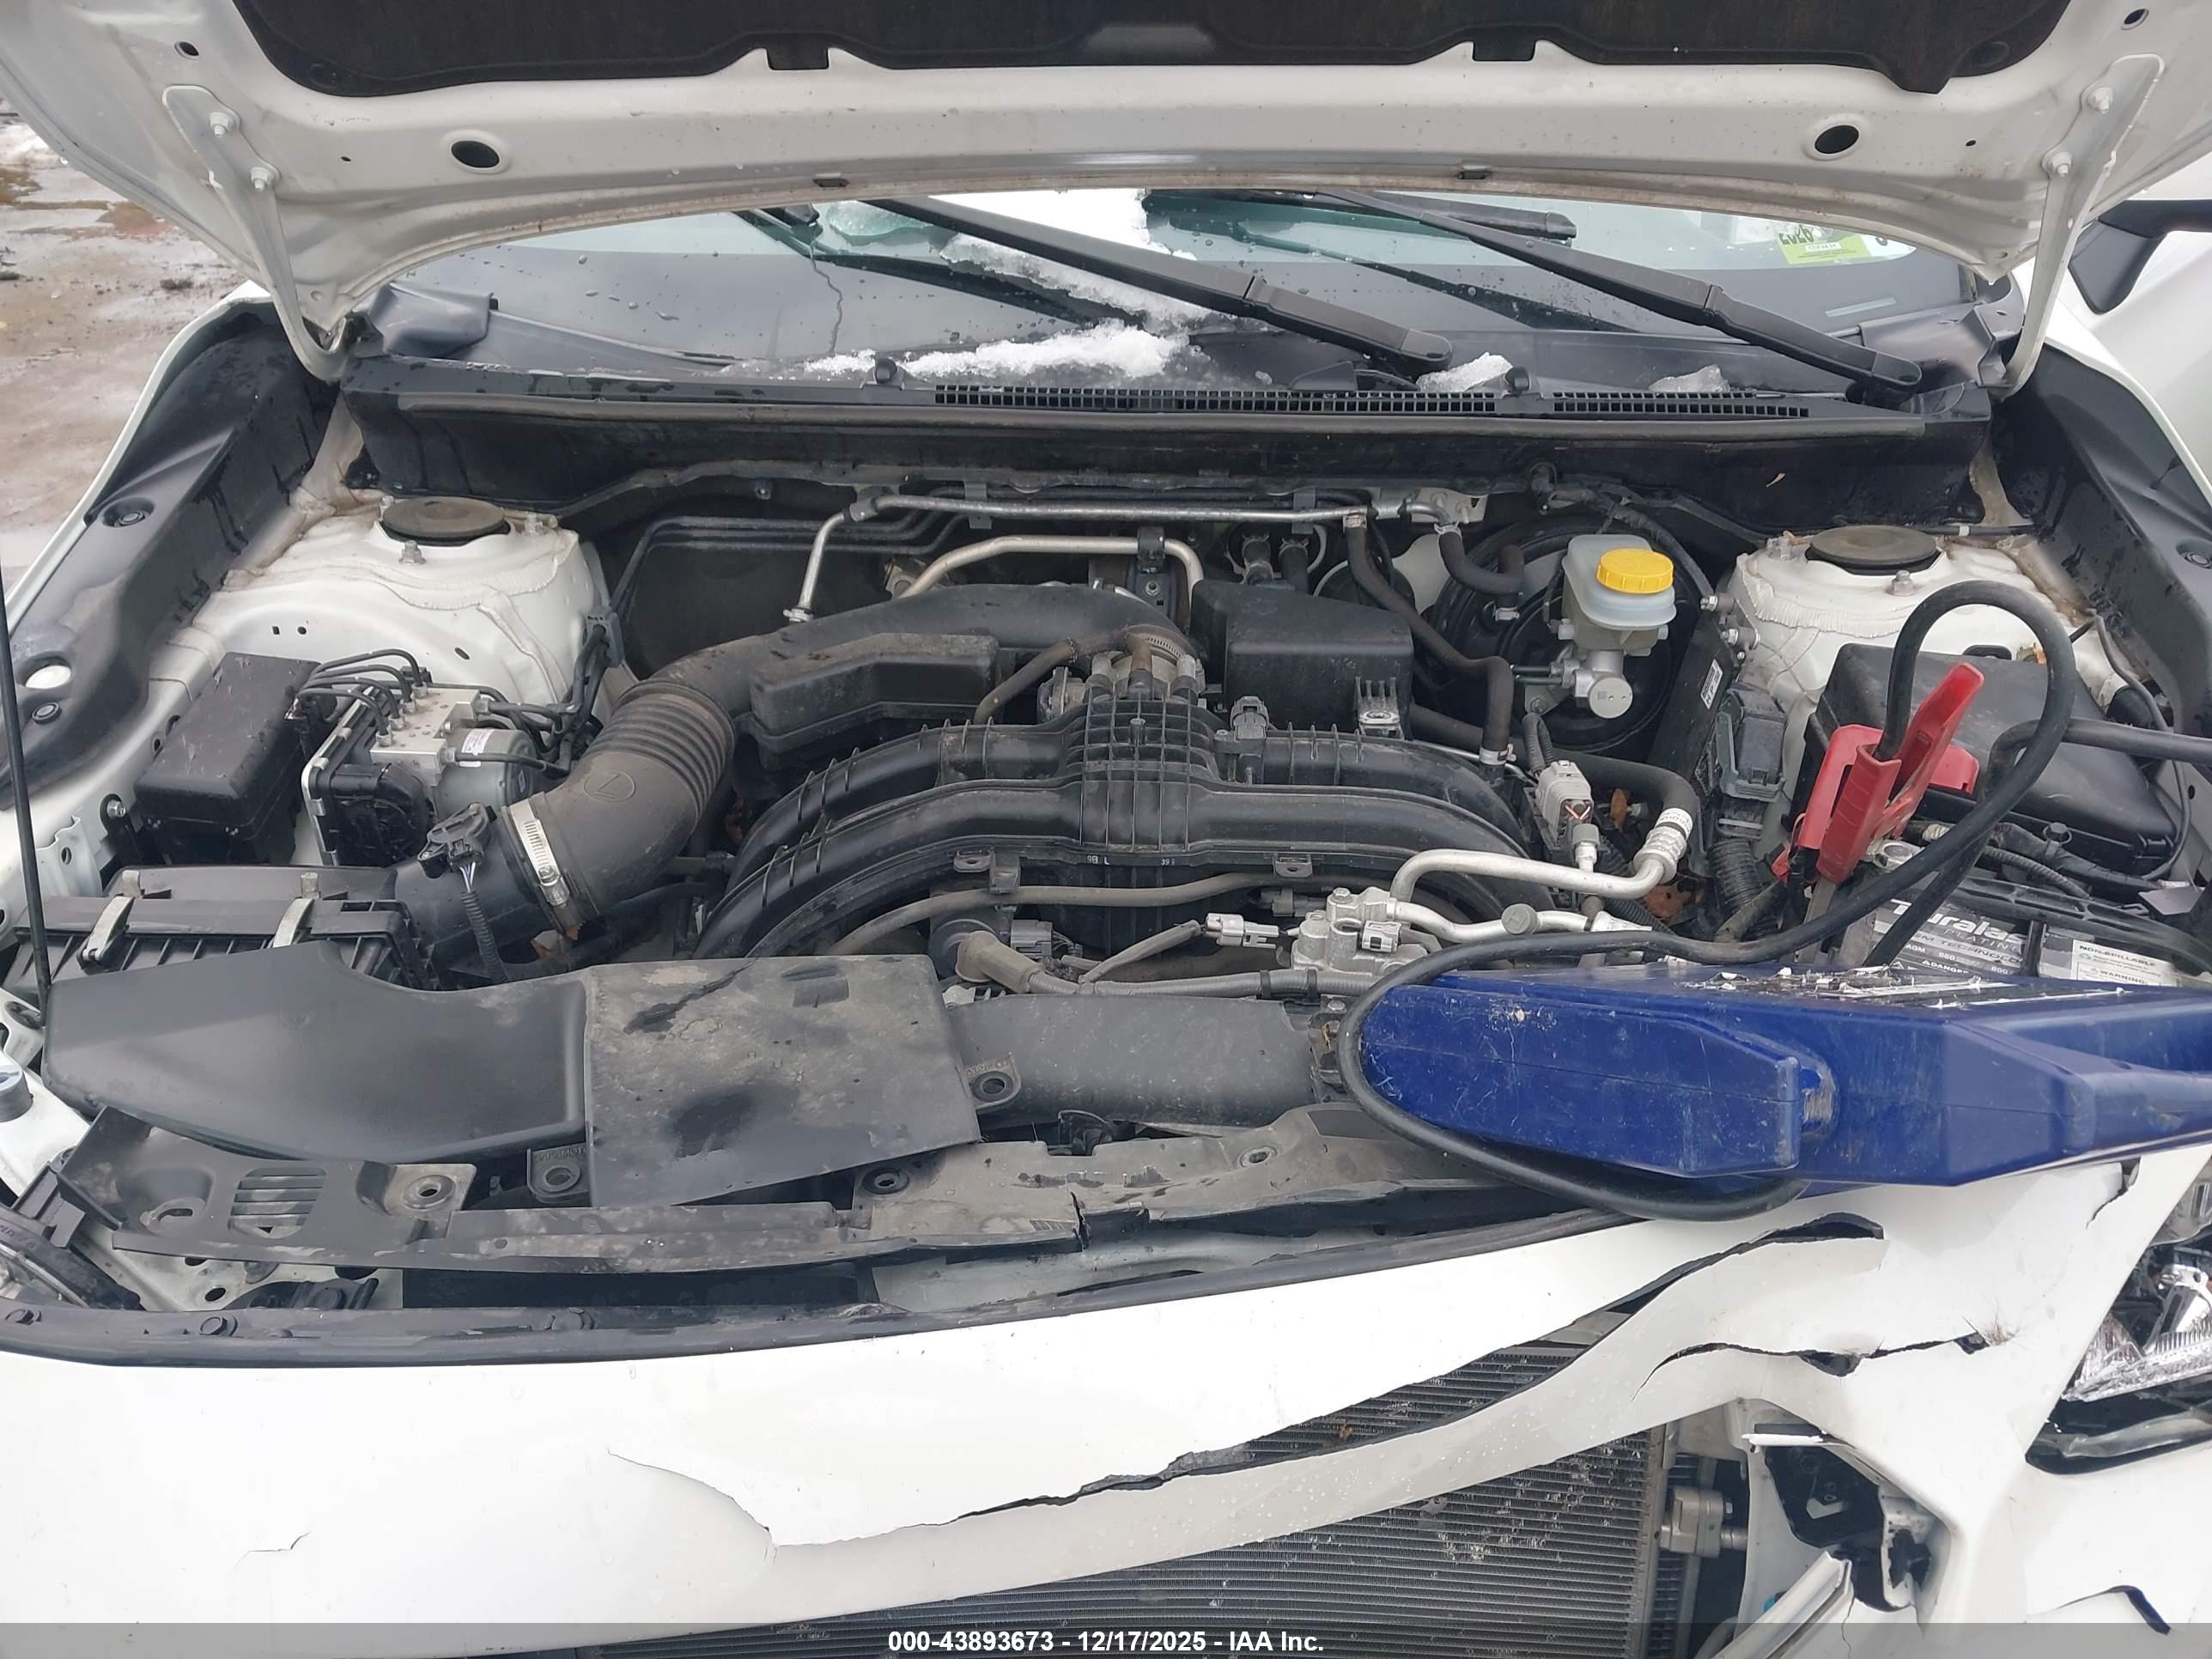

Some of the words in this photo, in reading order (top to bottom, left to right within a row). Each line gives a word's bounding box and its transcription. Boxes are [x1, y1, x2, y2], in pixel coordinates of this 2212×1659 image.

[1941, 939, 2021, 963] TECHNOLO
[1944, 928, 2020, 953] PLATIN
[2100, 969, 2146, 985] WARNING
